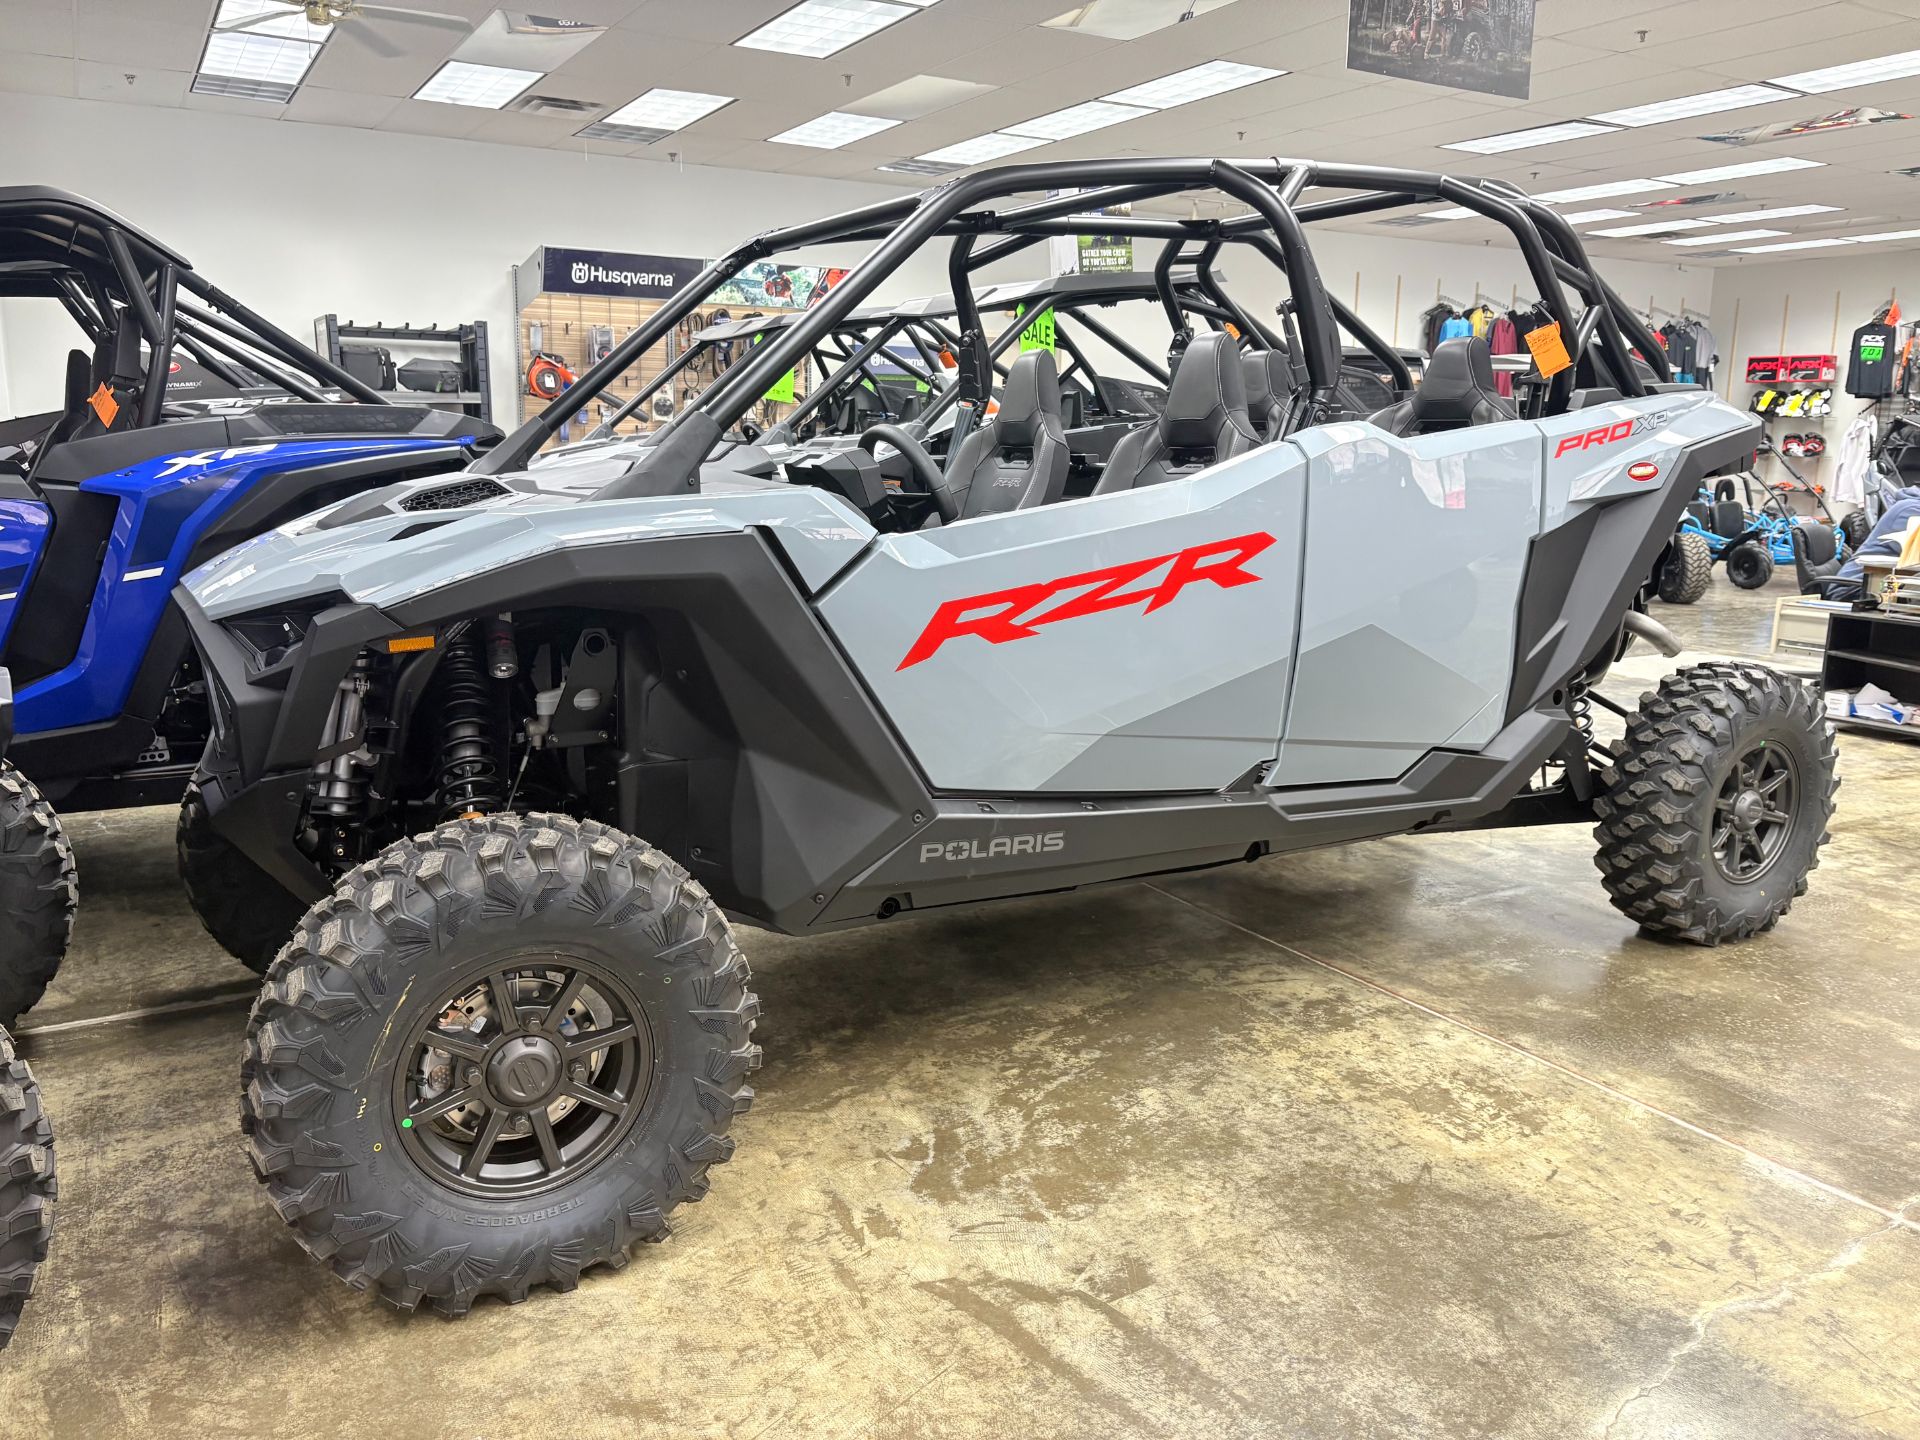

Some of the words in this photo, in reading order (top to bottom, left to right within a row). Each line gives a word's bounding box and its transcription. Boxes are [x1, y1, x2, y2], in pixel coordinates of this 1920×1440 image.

[1082, 258, 1090, 266] OR
[1117, 257, 1127, 265] OUT
[1112, 248, 1126, 256] CREW
[590, 266, 673, 287] Husqvarna
[1023, 322, 1050, 346] SALE
[1554, 419, 1634, 459] PRO
[154, 443, 279, 479] XP
[898, 531, 1278, 670] RZR
[920, 830, 1065, 863] POLARIS
